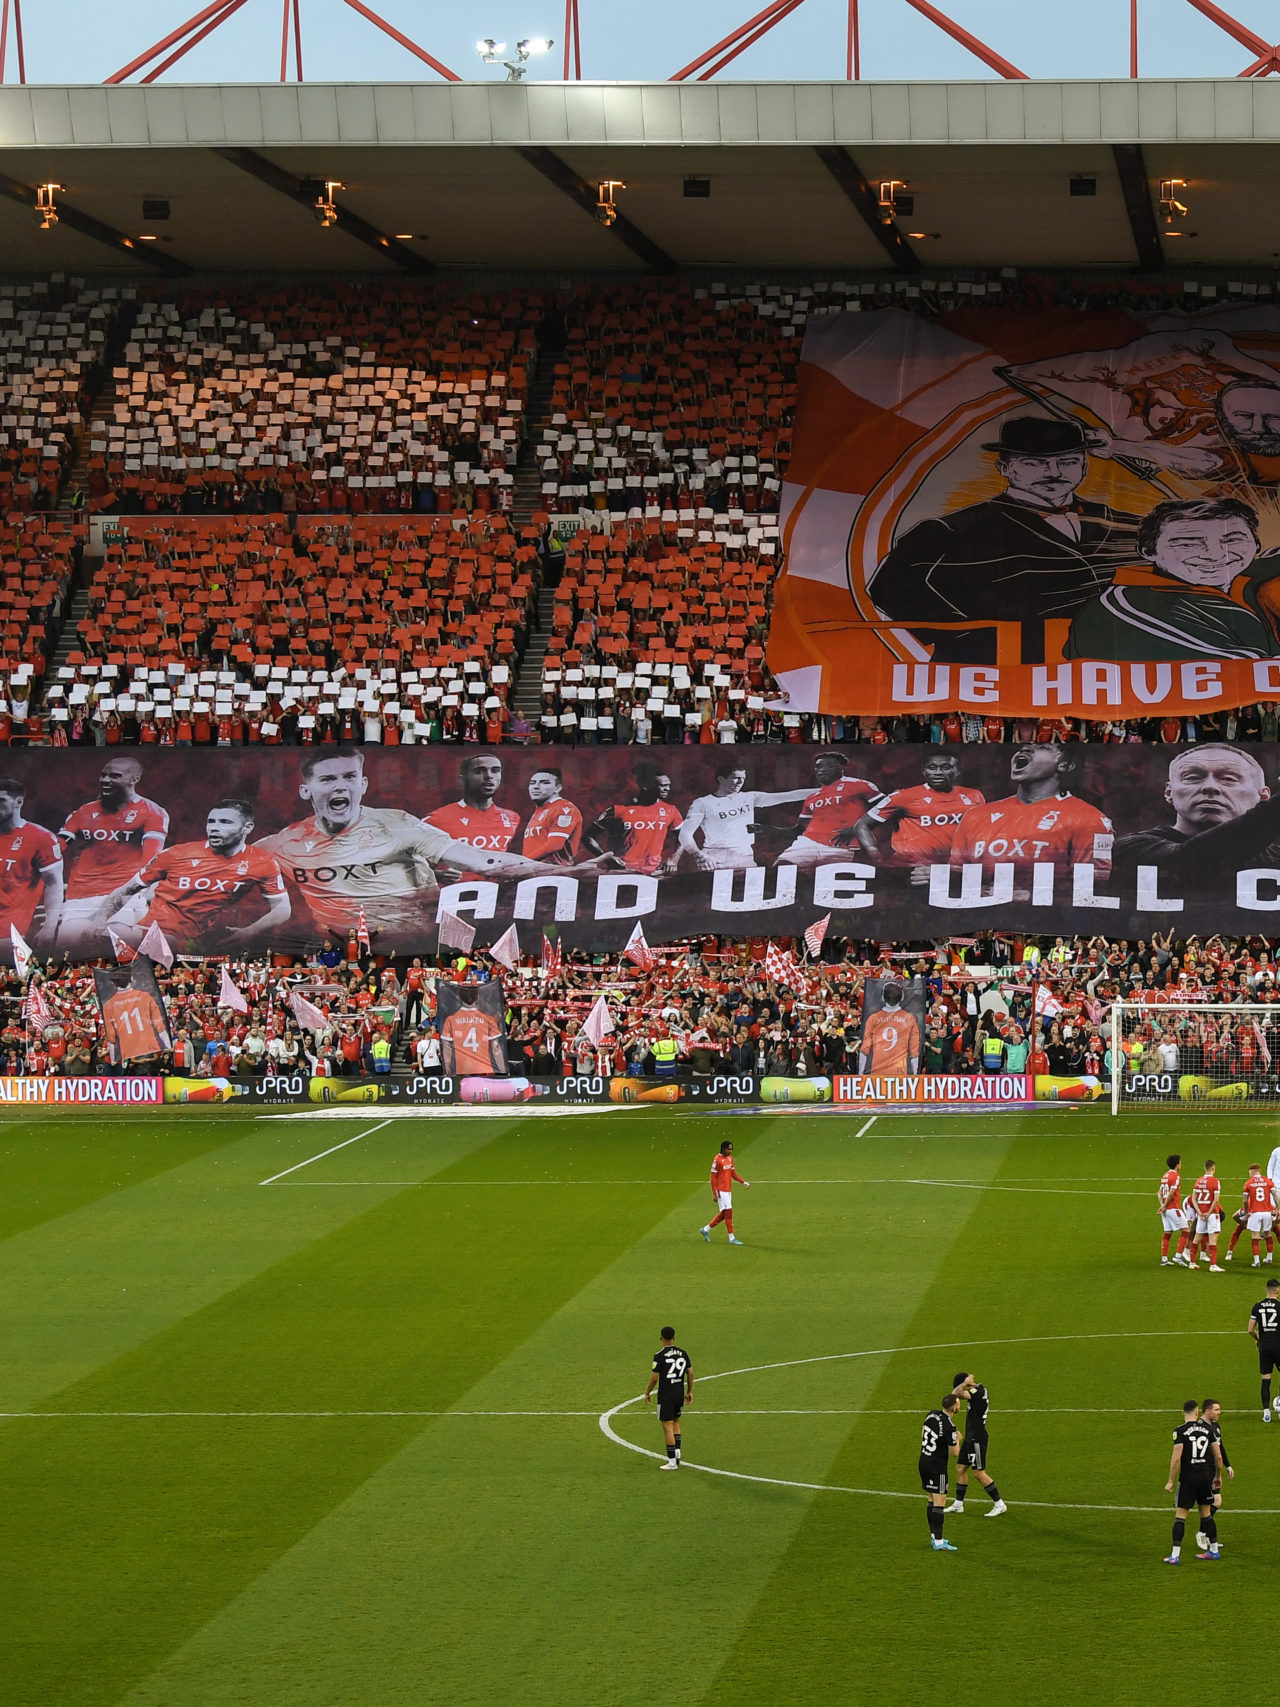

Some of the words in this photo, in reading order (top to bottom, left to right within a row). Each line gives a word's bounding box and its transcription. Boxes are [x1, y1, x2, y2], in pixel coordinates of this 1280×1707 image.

[103, 522, 119, 531] EXI
[559, 522, 579, 531] EXIT
[892, 663, 999, 702] WE
[1032, 661, 1223, 706] HAVE
[809, 795, 842, 811] BOXT
[82, 828, 134, 842] BOXT
[625, 821, 666, 831] BOXT
[974, 839, 1050, 859] BOXT
[294, 862, 381, 885] BOXT
[178, 876, 245, 893] BOXT
[436, 874, 659, 924] AND
[711, 862, 876, 912] WE
[928, 862, 1184, 912] WILL
[989, 968, 1014, 977] EXIT
[119, 1007, 144, 1035] 11
[455, 1017, 485, 1025] WALKER
[462, 1026, 480, 1053] 4
[881, 1026, 898, 1052] 9
[54, 1078, 158, 1101] HYDRATION
[839, 1077, 919, 1100] HEALTHY
[924, 1077, 1026, 1100] HYDRATION
[1193, 1189, 1211, 1204] 22
[1256, 1187, 1265, 1202] 8
[1258, 1308, 1278, 1328] 12
[665, 1357, 687, 1379] 29
[1189, 1435, 1209, 1458] 19
